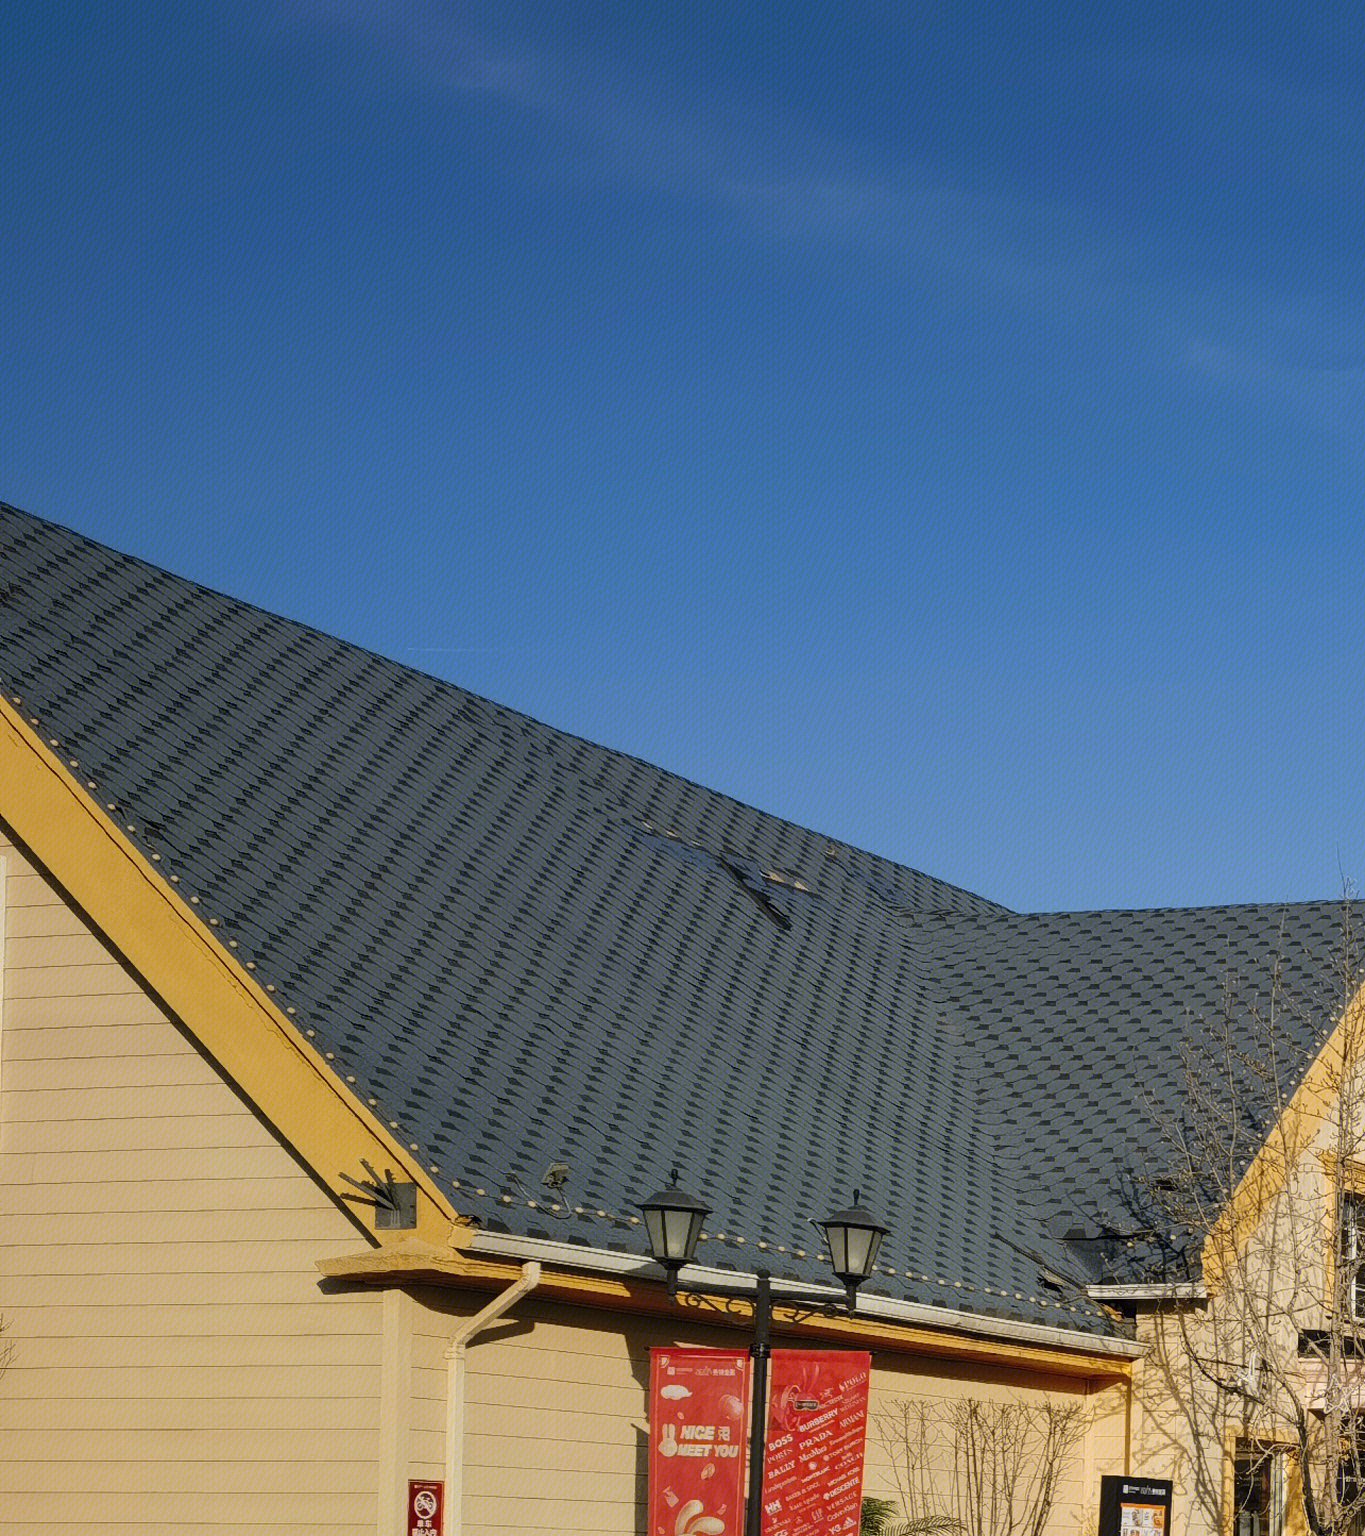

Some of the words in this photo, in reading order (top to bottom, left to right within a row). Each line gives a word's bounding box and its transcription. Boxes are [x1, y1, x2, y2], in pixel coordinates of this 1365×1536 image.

[680, 1425, 716, 1440] NICE
[768, 1433, 794, 1451] BOSS
[677, 1444, 713, 1457] MEET
[713, 1445, 739, 1458] YOU
